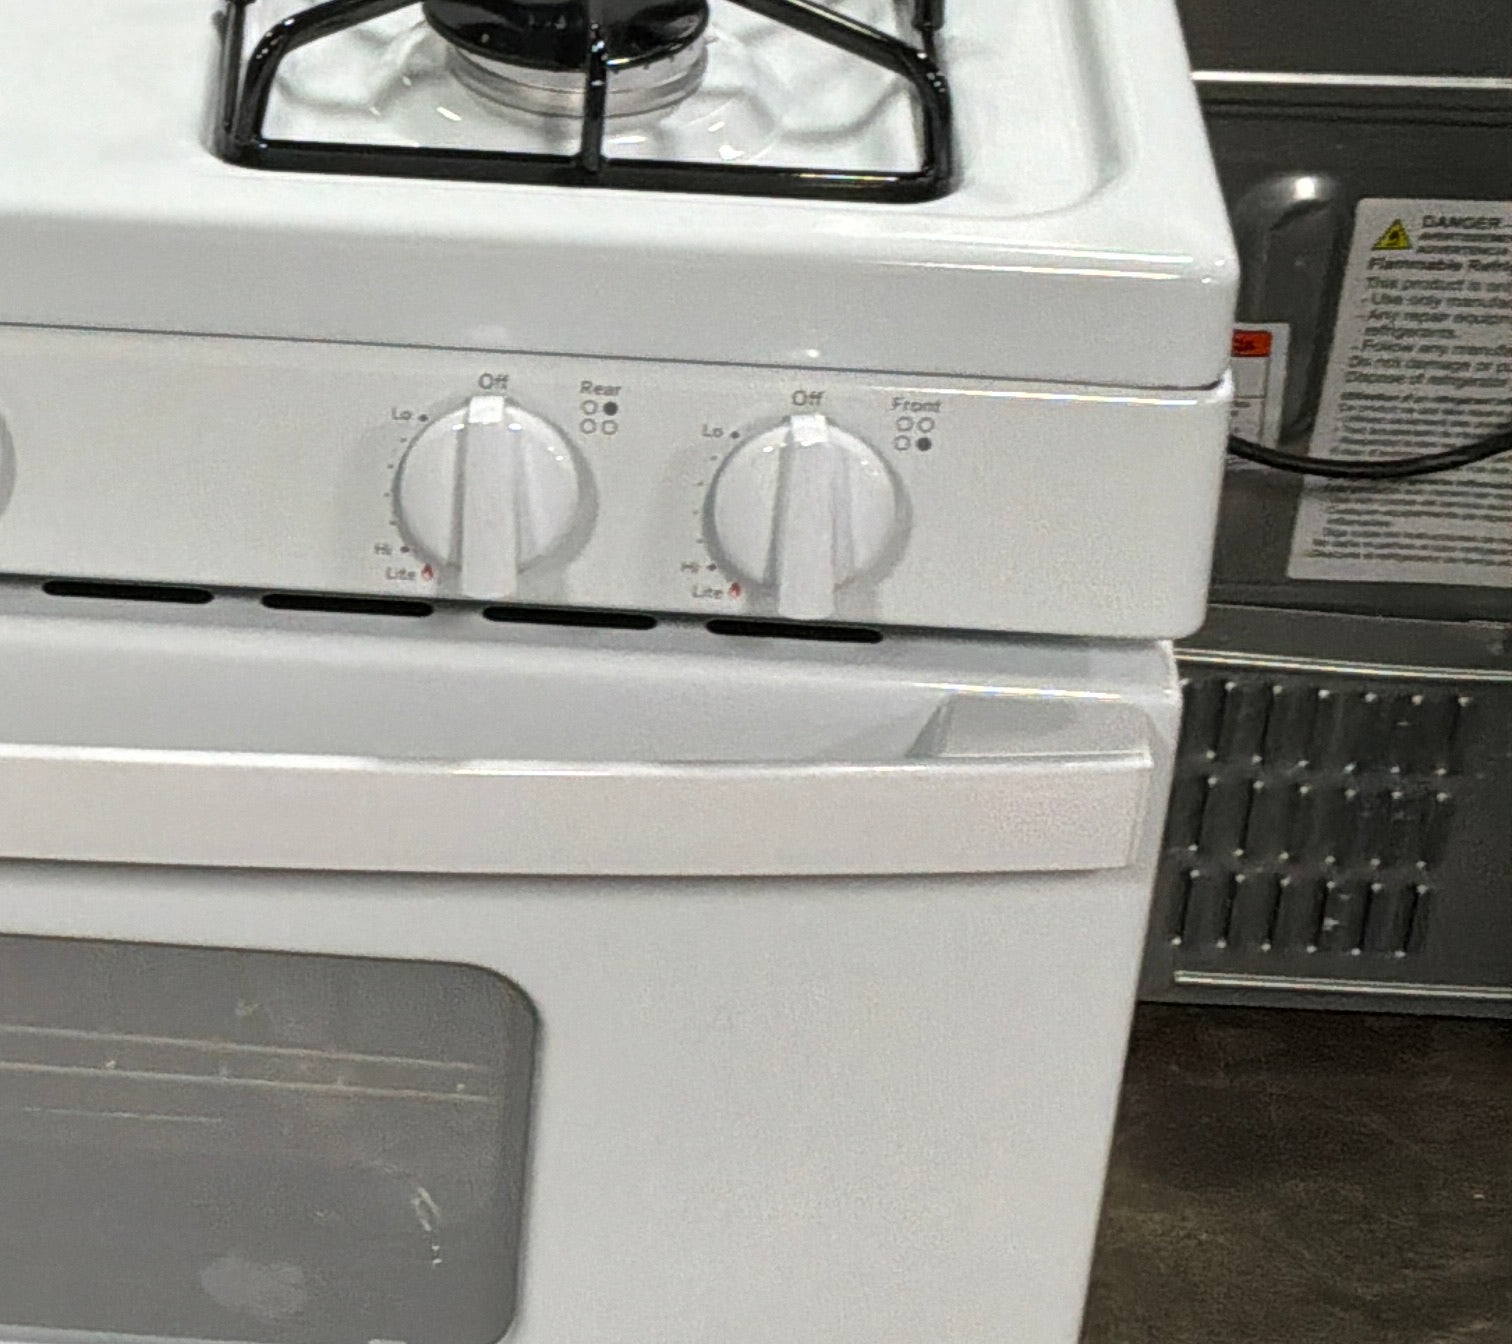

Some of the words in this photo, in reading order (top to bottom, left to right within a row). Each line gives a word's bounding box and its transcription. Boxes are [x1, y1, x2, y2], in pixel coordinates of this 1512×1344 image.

[478, 373, 510, 390] Off
[579, 380, 622, 397] Rear
[791, 389, 825, 407] Off
[891, 396, 942, 413] Front
[391, 408, 413, 421] Lo
[702, 423, 724, 438] Lo
